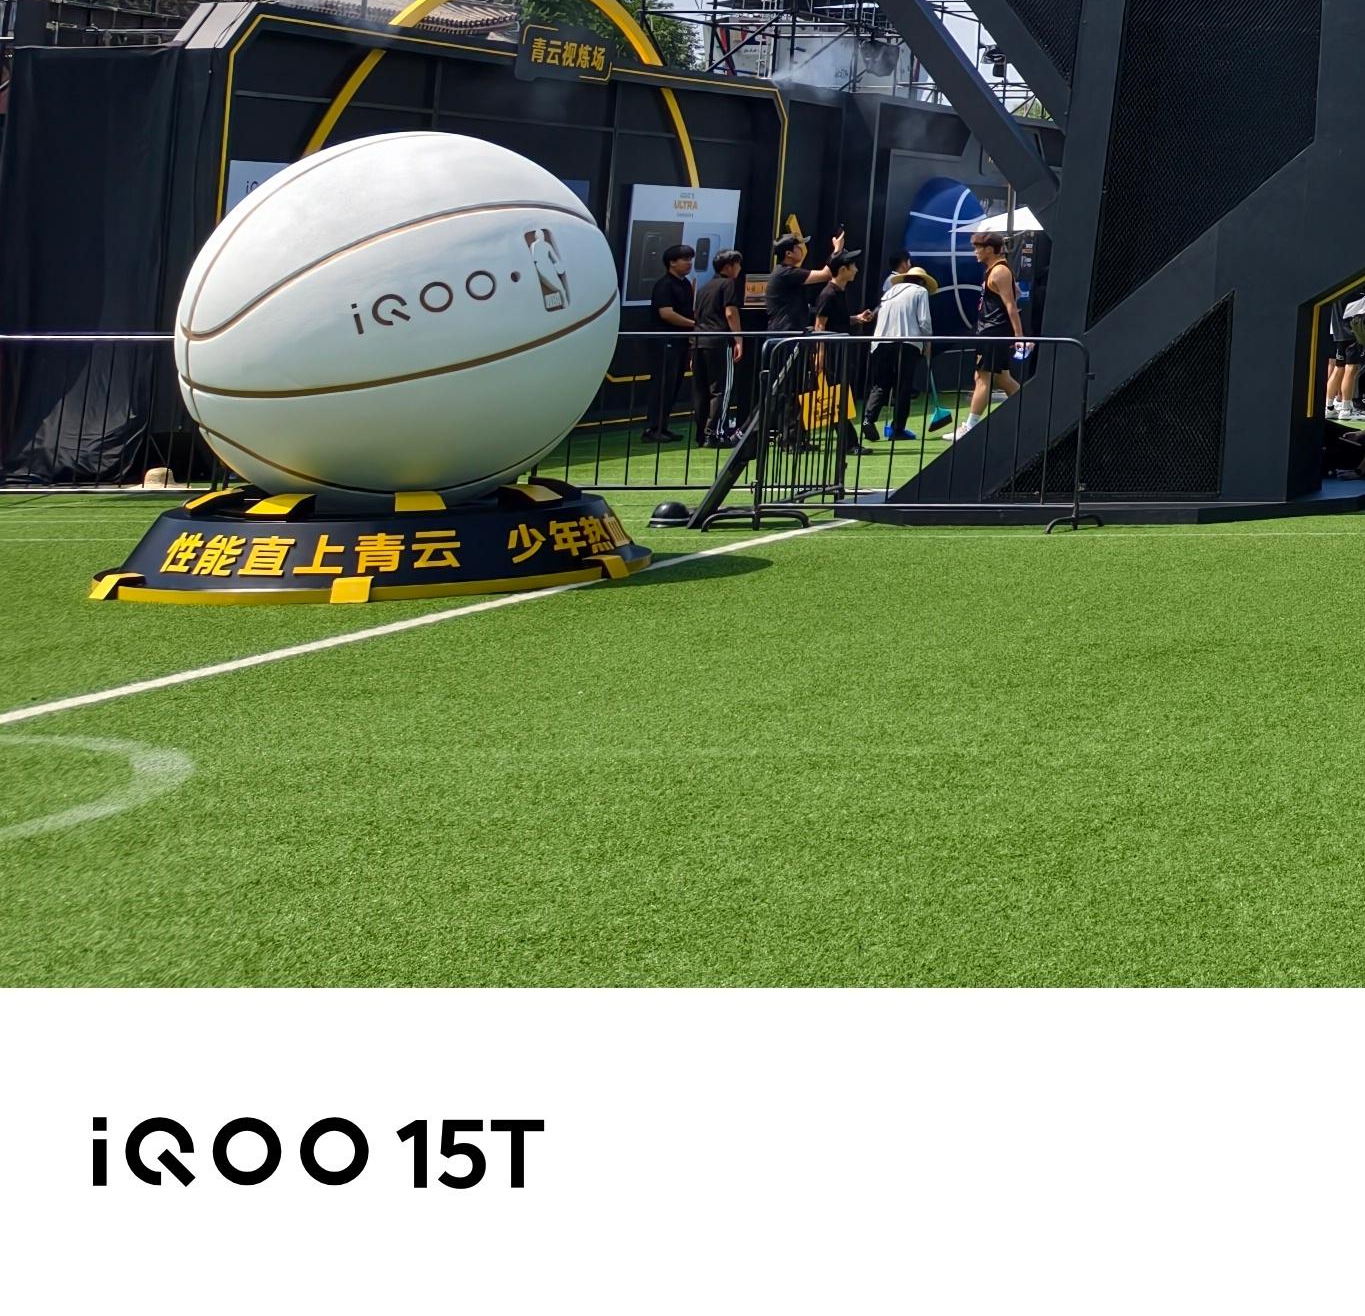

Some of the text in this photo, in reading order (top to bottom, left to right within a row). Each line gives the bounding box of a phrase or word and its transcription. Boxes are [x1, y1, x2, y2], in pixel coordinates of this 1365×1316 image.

[351, 270, 497, 335] iQOO
[159, 530, 462, 578] 性能直上青云
